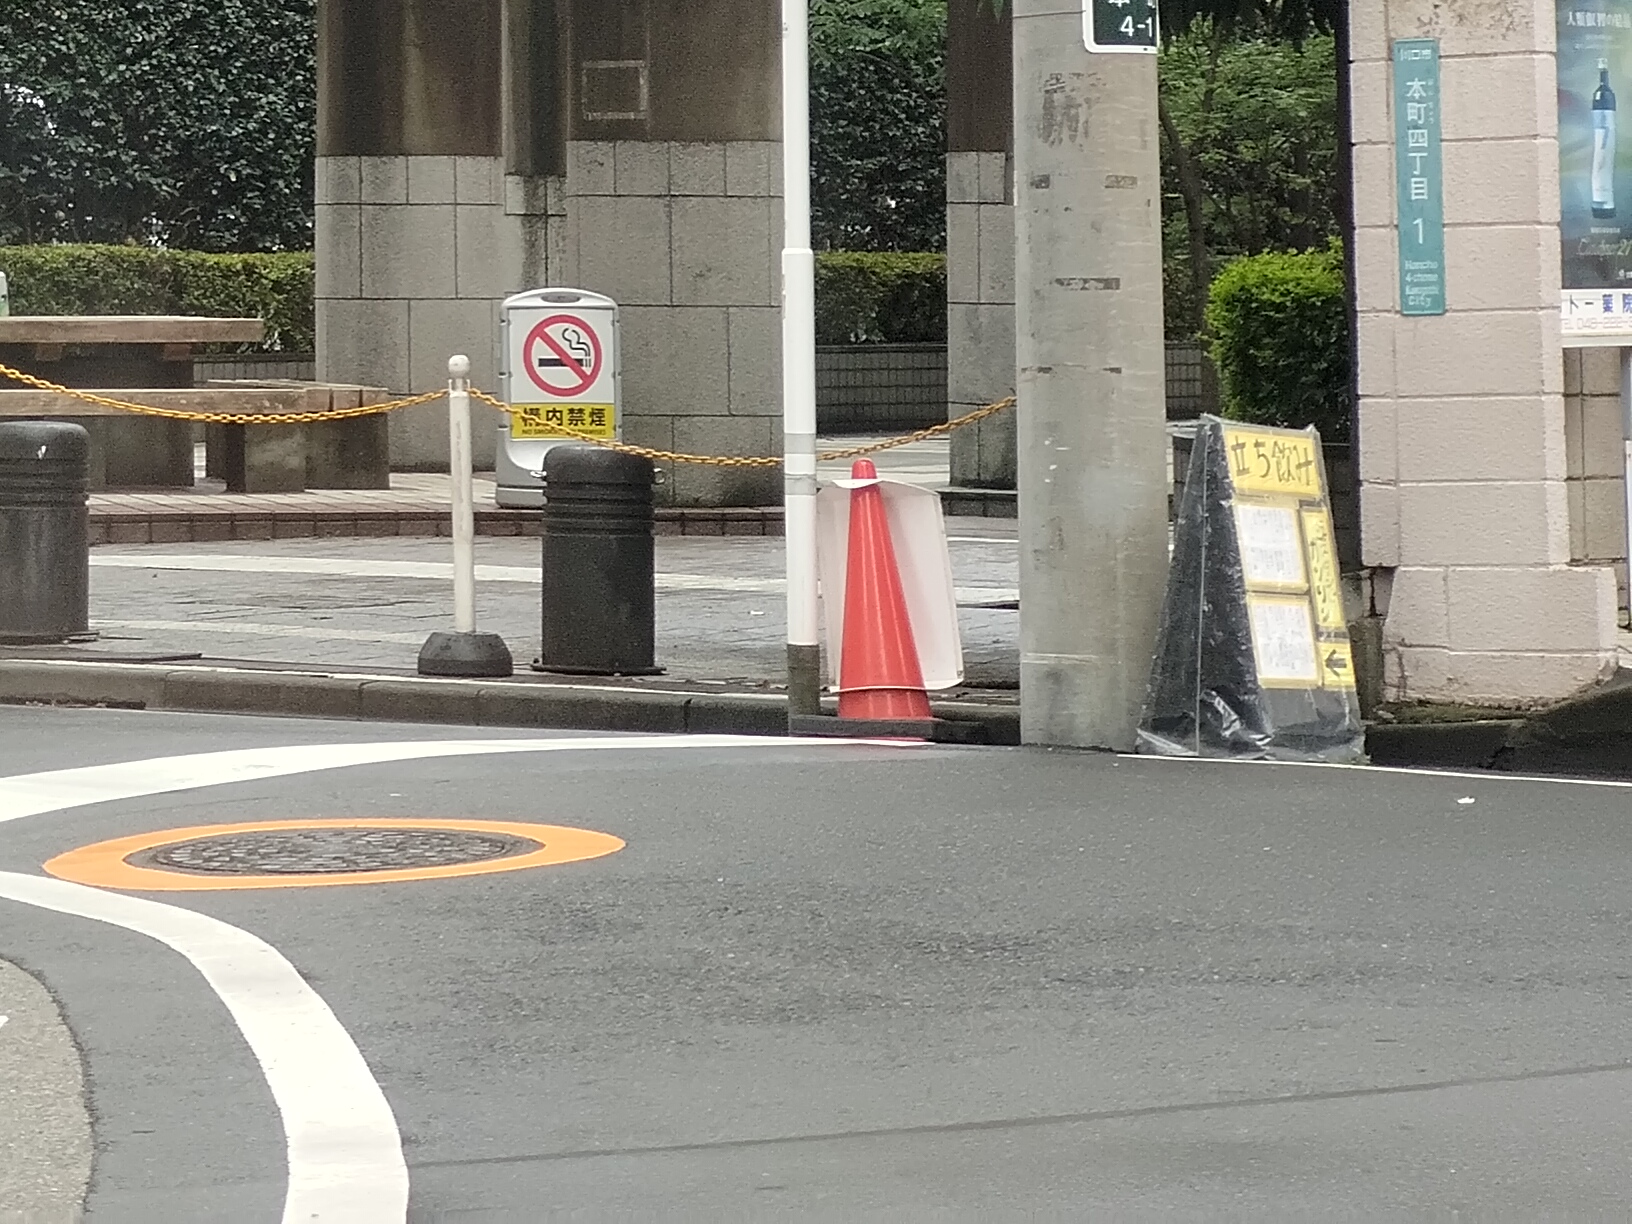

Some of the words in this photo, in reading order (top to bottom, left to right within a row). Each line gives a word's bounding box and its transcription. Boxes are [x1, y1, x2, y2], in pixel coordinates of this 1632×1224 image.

[1405, 77, 1429, 201] 本町四丁目
[1412, 217, 1424, 245] 1
